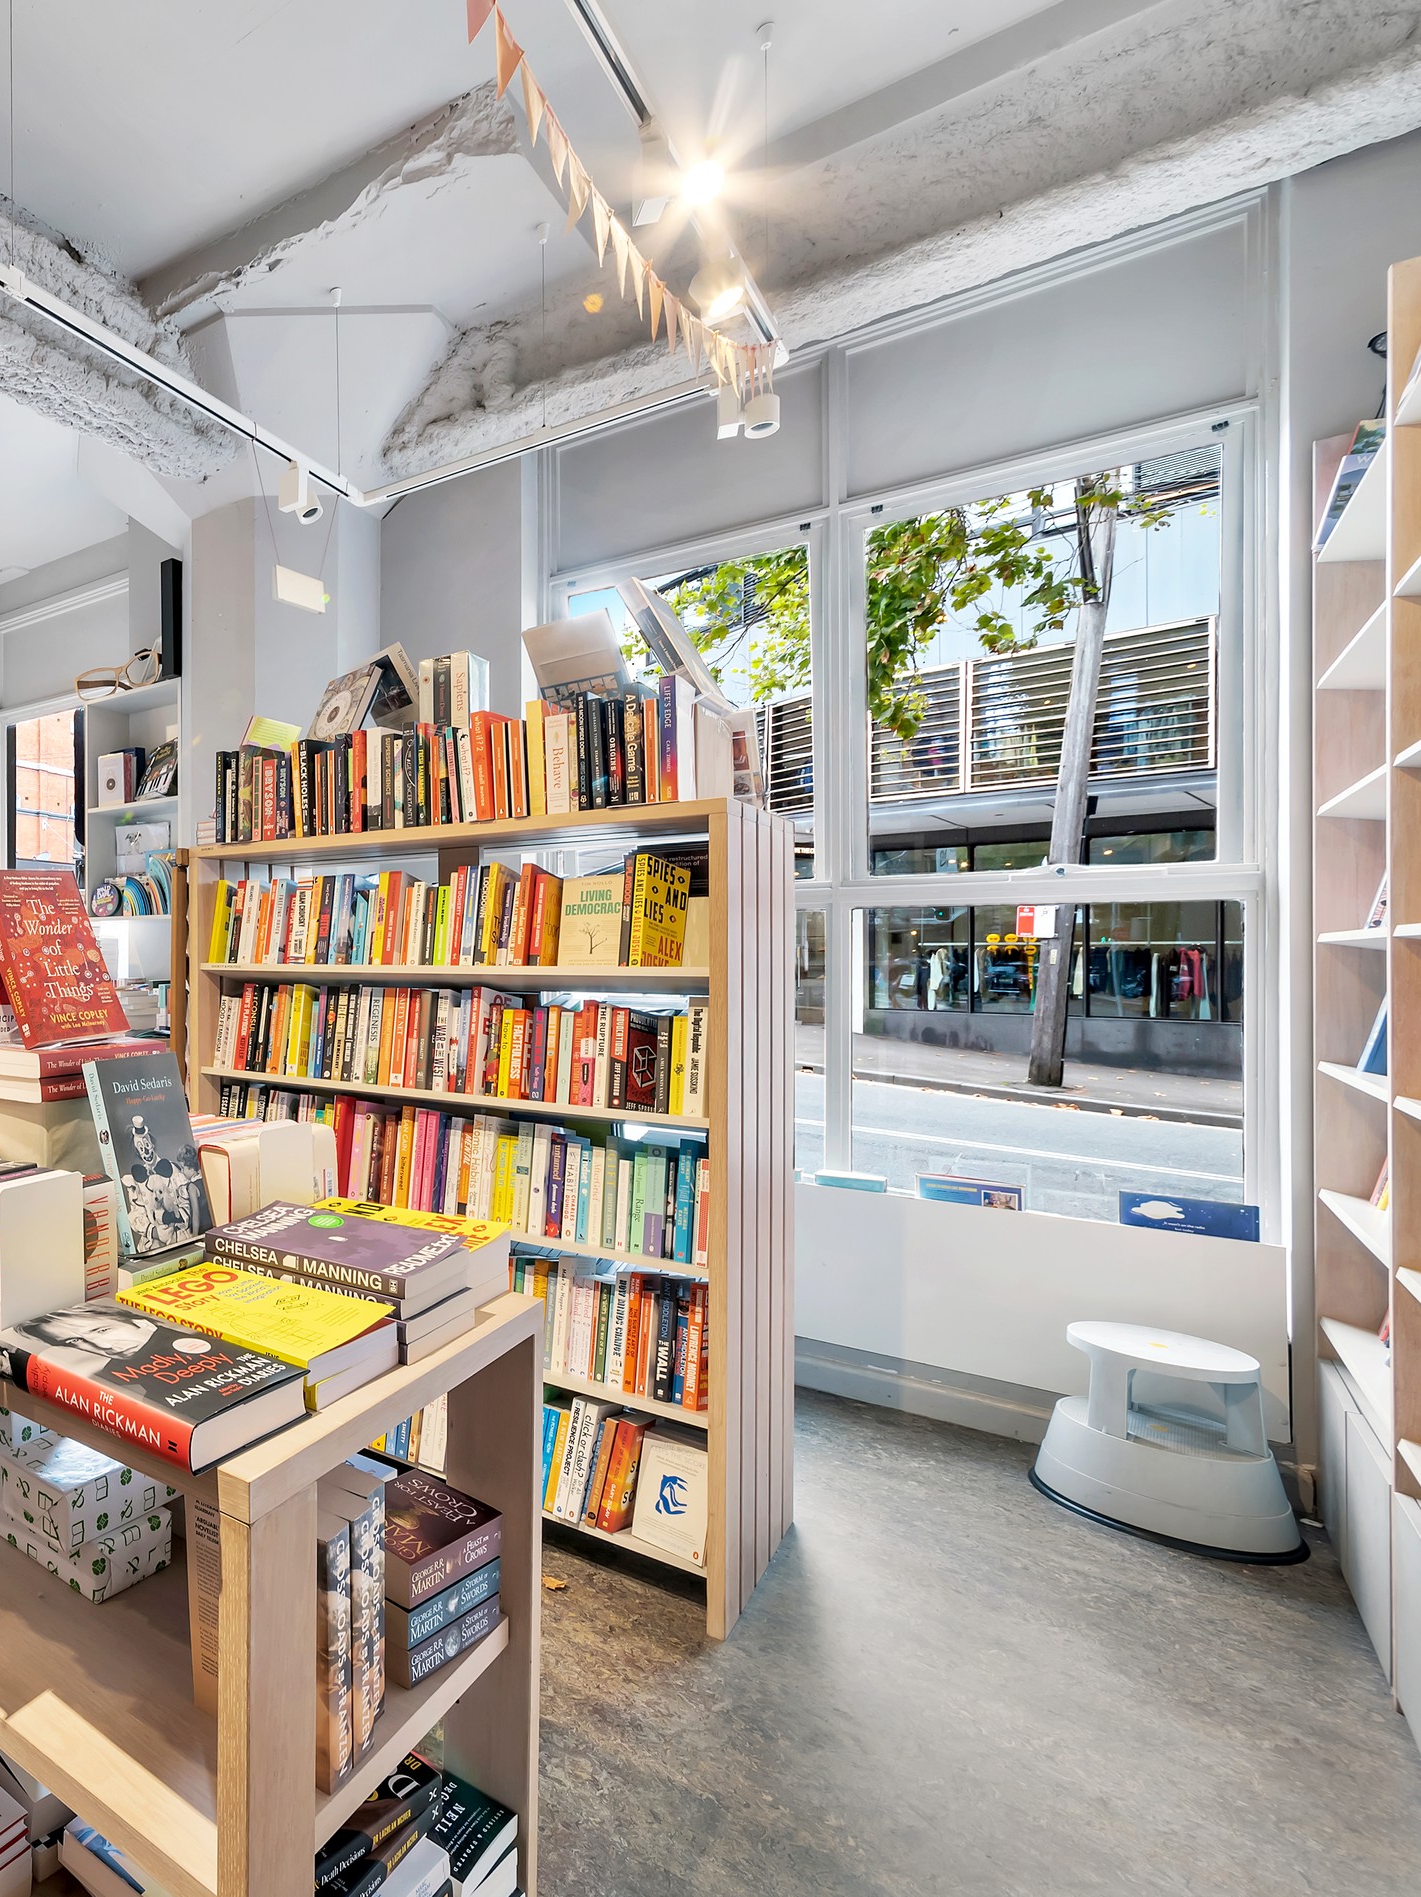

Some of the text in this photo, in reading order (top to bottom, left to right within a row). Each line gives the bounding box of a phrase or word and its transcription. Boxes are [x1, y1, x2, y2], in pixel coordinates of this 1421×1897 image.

[553, 747, 564, 788] Behave
[264, 770, 276, 814] BRYSON
[647, 856, 675, 885] SPIES
[26, 899, 55, 915] The
[565, 901, 621, 915] DEMOCRAC
[581, 889, 612, 902] LIVING
[665, 886, 687, 911] AND
[644, 898, 664, 924] LIES
[24, 919, 72, 935] Wonder
[50, 939, 61, 955] of
[658, 936, 681, 961] ALEX
[44, 961, 80, 977] Little
[7, 968, 25, 1017] VINCE COPLEY
[44, 982, 95, 1002] Things
[50, 1009, 108, 1023] VINCE COPLEY
[598, 1020, 606, 1057] RUPTURE
[616, 1010, 625, 1056] PROVOCATIONS
[510, 1023, 522, 1080] FACTFULNESS
[113, 1076, 172, 1093] David Sedaris
[222, 1206, 292, 1234] CHELSEA
[238, 1208, 314, 1241] MANNING
[86, 1195, 110, 1299] VANDERBI
[186, 1268, 208, 1277] The
[215, 1239, 382, 1290] CHELSEA MANNING
[143, 1271, 238, 1305] LEGO
[175, 1294, 220, 1311] Story
[661, 1298, 670, 1338] MIDDLETON
[112, 1352, 193, 1383] Madly,
[153, 1352, 233, 1385] Deeply
[236, 1352, 256, 1362] THE
[656, 1346, 669, 1381] WALL
[686, 1326, 699, 1393] LAWRENCE MOONEY
[165, 1356, 273, 1407] ALAN RICKMAN
[243, 1363, 286, 1386] DIARIES
[99, 1391, 114, 1405] THE
[55, 1385, 160, 1447] ALAN RICKMAN
[92, 1419, 121, 1439] DIARIES
[563, 1407, 580, 1476] RESILIENCE PROJECT
[408, 1478, 477, 1516] CROWS
[420, 1498, 457, 1522] FEAST
[465, 1544, 487, 1564] CROWS
[467, 1536, 483, 1550] FEAST
[411, 1567, 432, 1583] GEORGE
[412, 1569, 445, 1598] MARTIN
[410, 1612, 431, 1627] GEORGE
[411, 1613, 443, 1642] MARTIN
[462, 1619, 488, 1640] SWORDS
[466, 1612, 483, 1626] STORM
[360, 1520, 370, 1751] CROSSROADS FRANZEN
[337, 1539, 348, 1777] CROSSROADS FRANZEN
[411, 1649, 432, 1665] GEORGE
[412, 1648, 445, 1681] MARTIN
[435, 1804, 465, 1833] NEIL
[321, 1847, 366, 1887] Death Decisions
